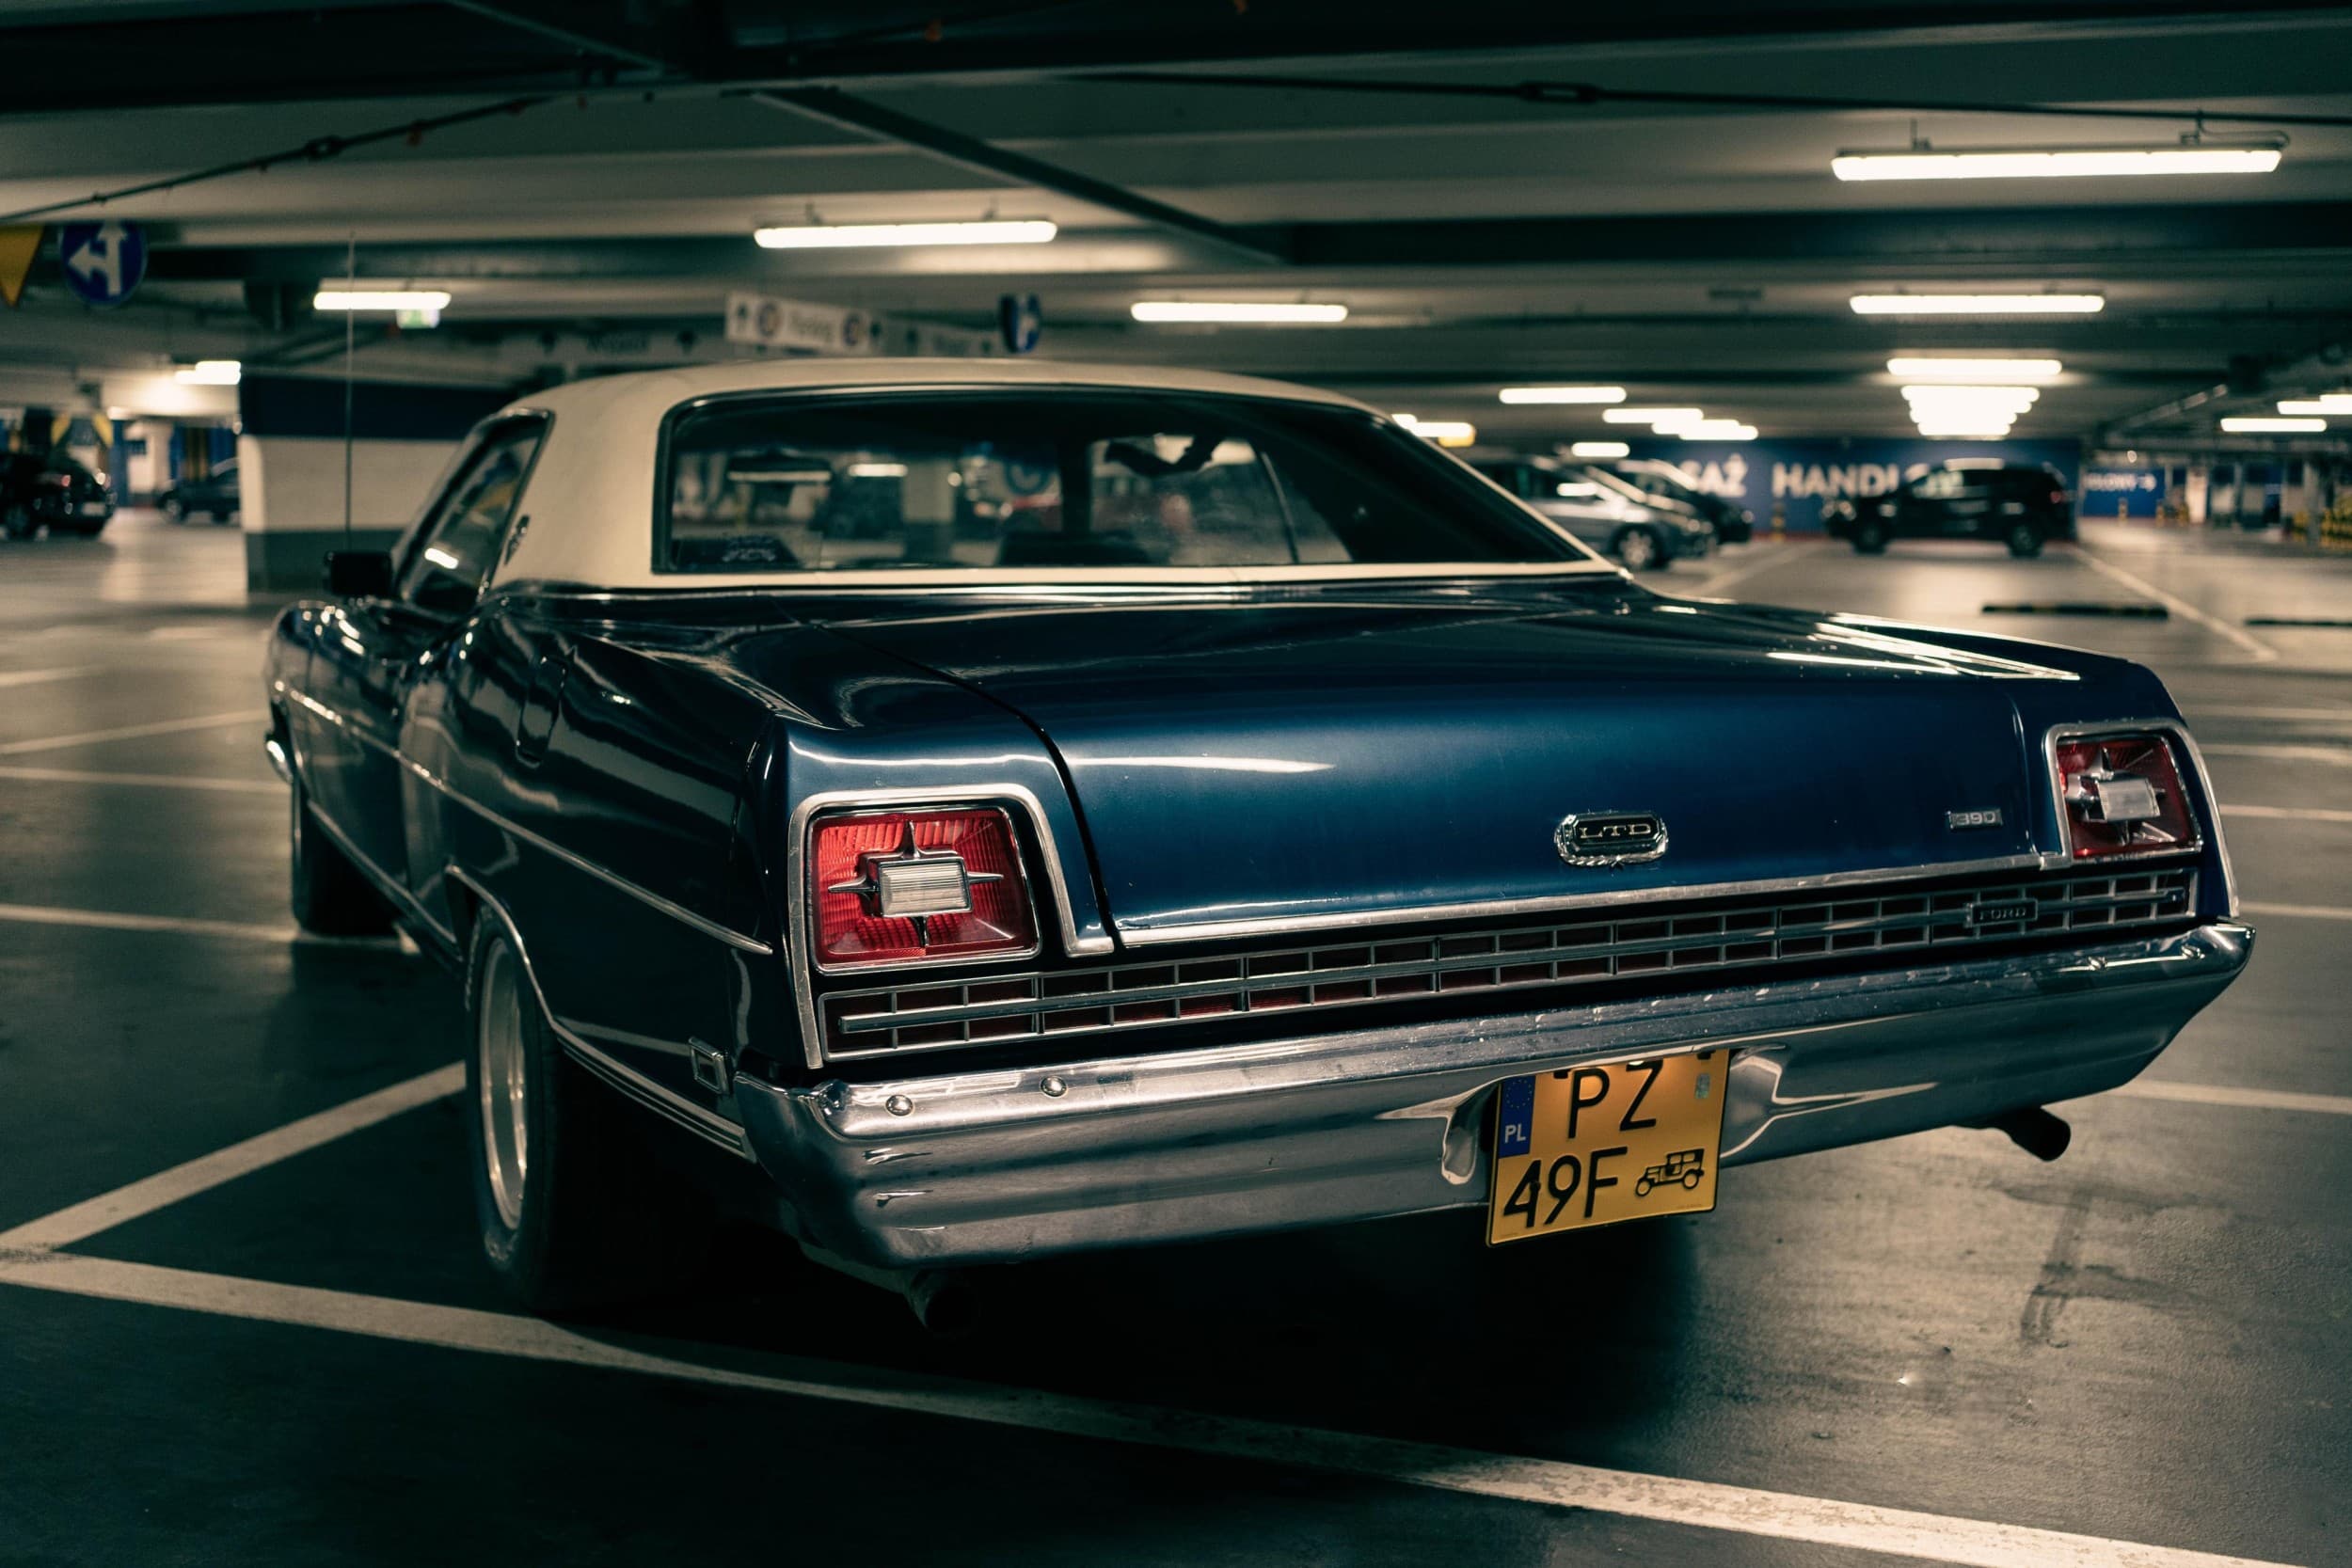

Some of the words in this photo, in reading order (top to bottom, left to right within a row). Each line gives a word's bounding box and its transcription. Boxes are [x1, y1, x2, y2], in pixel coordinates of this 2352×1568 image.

[1956, 812, 1995, 826] 390
[1577, 823, 1651, 839] LTD
[1979, 907, 2026, 921] FORD
[1567, 1058, 1663, 1139] PZ
[1504, 1124, 1526, 1144] PL
[1503, 1146, 1628, 1227] 49F
